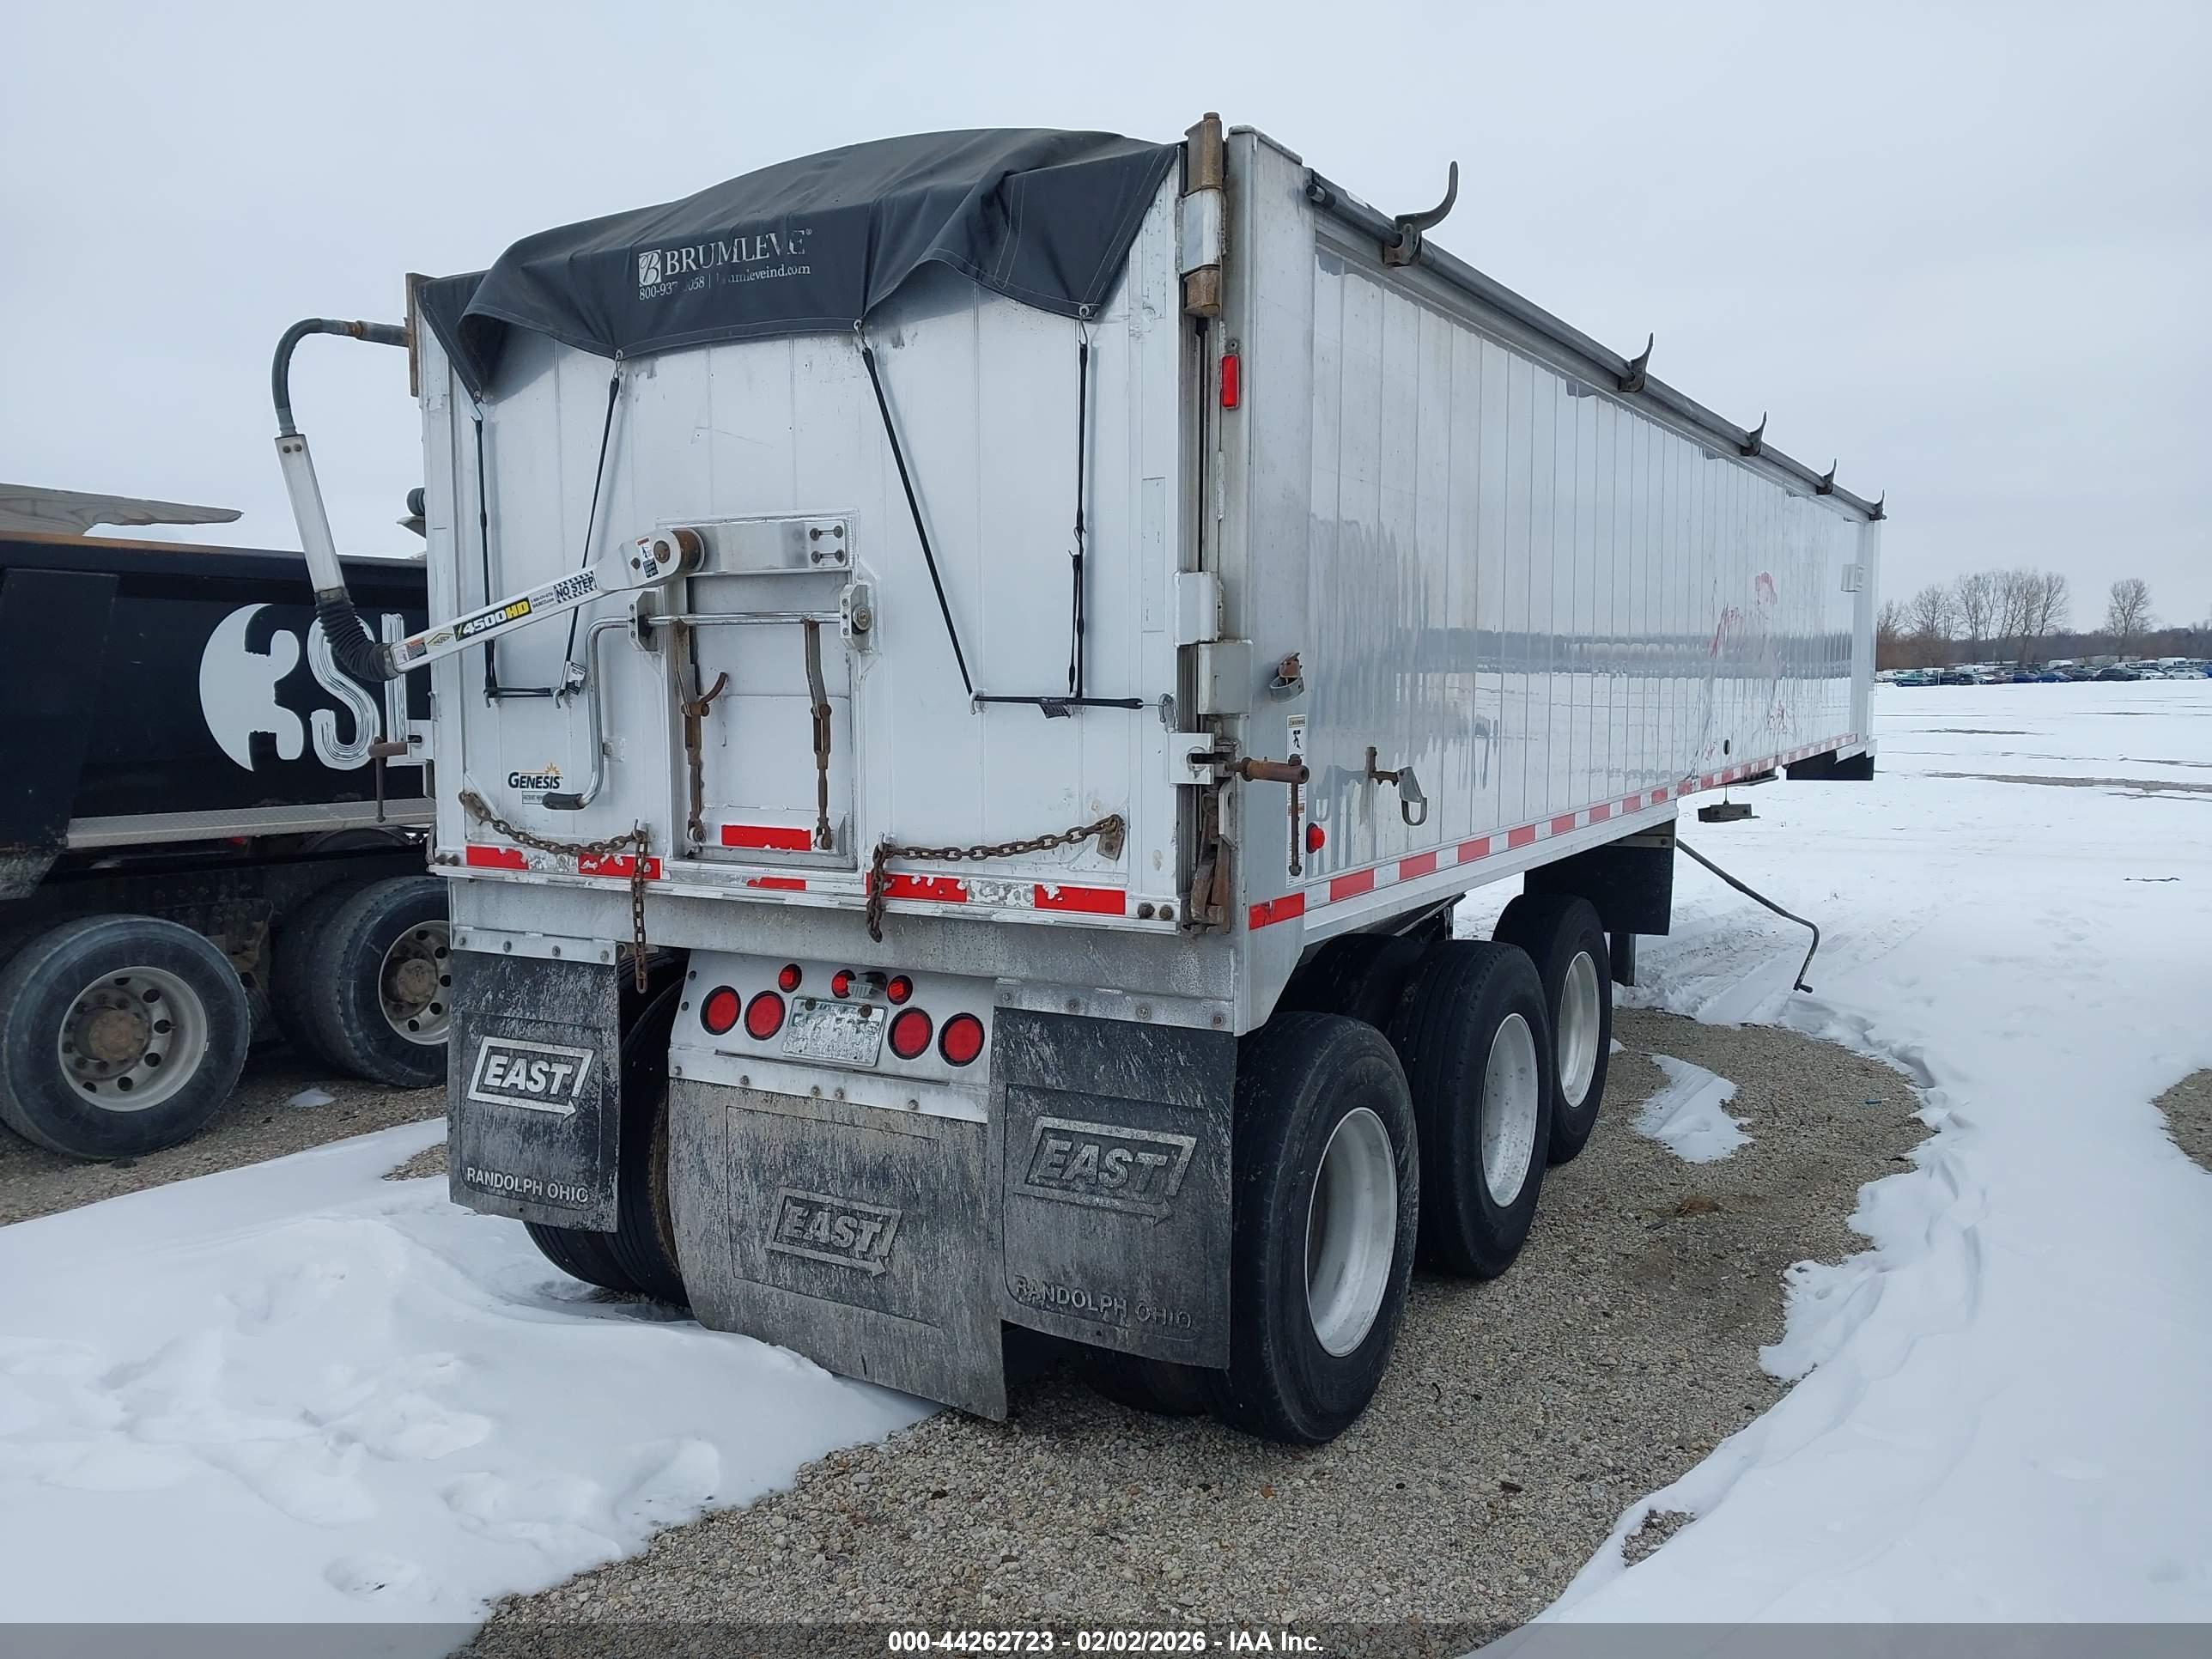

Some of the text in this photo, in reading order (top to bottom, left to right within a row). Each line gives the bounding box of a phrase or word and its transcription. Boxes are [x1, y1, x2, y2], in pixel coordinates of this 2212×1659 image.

[639, 275, 705, 301] 800-93058
[716, 264, 811, 285] umleveind.com
[556, 585, 570, 599] NO
[572, 576, 594, 594] STEP
[507, 772, 561, 789] GENESIS
[483, 1054, 573, 1095] EAST
[1037, 1137, 1168, 1193] EAST
[467, 1167, 589, 1203] RANDOLPH OHIO
[782, 1206, 884, 1252] EAST
[1014, 1274, 1193, 1329] RANDOLPH OHIO
